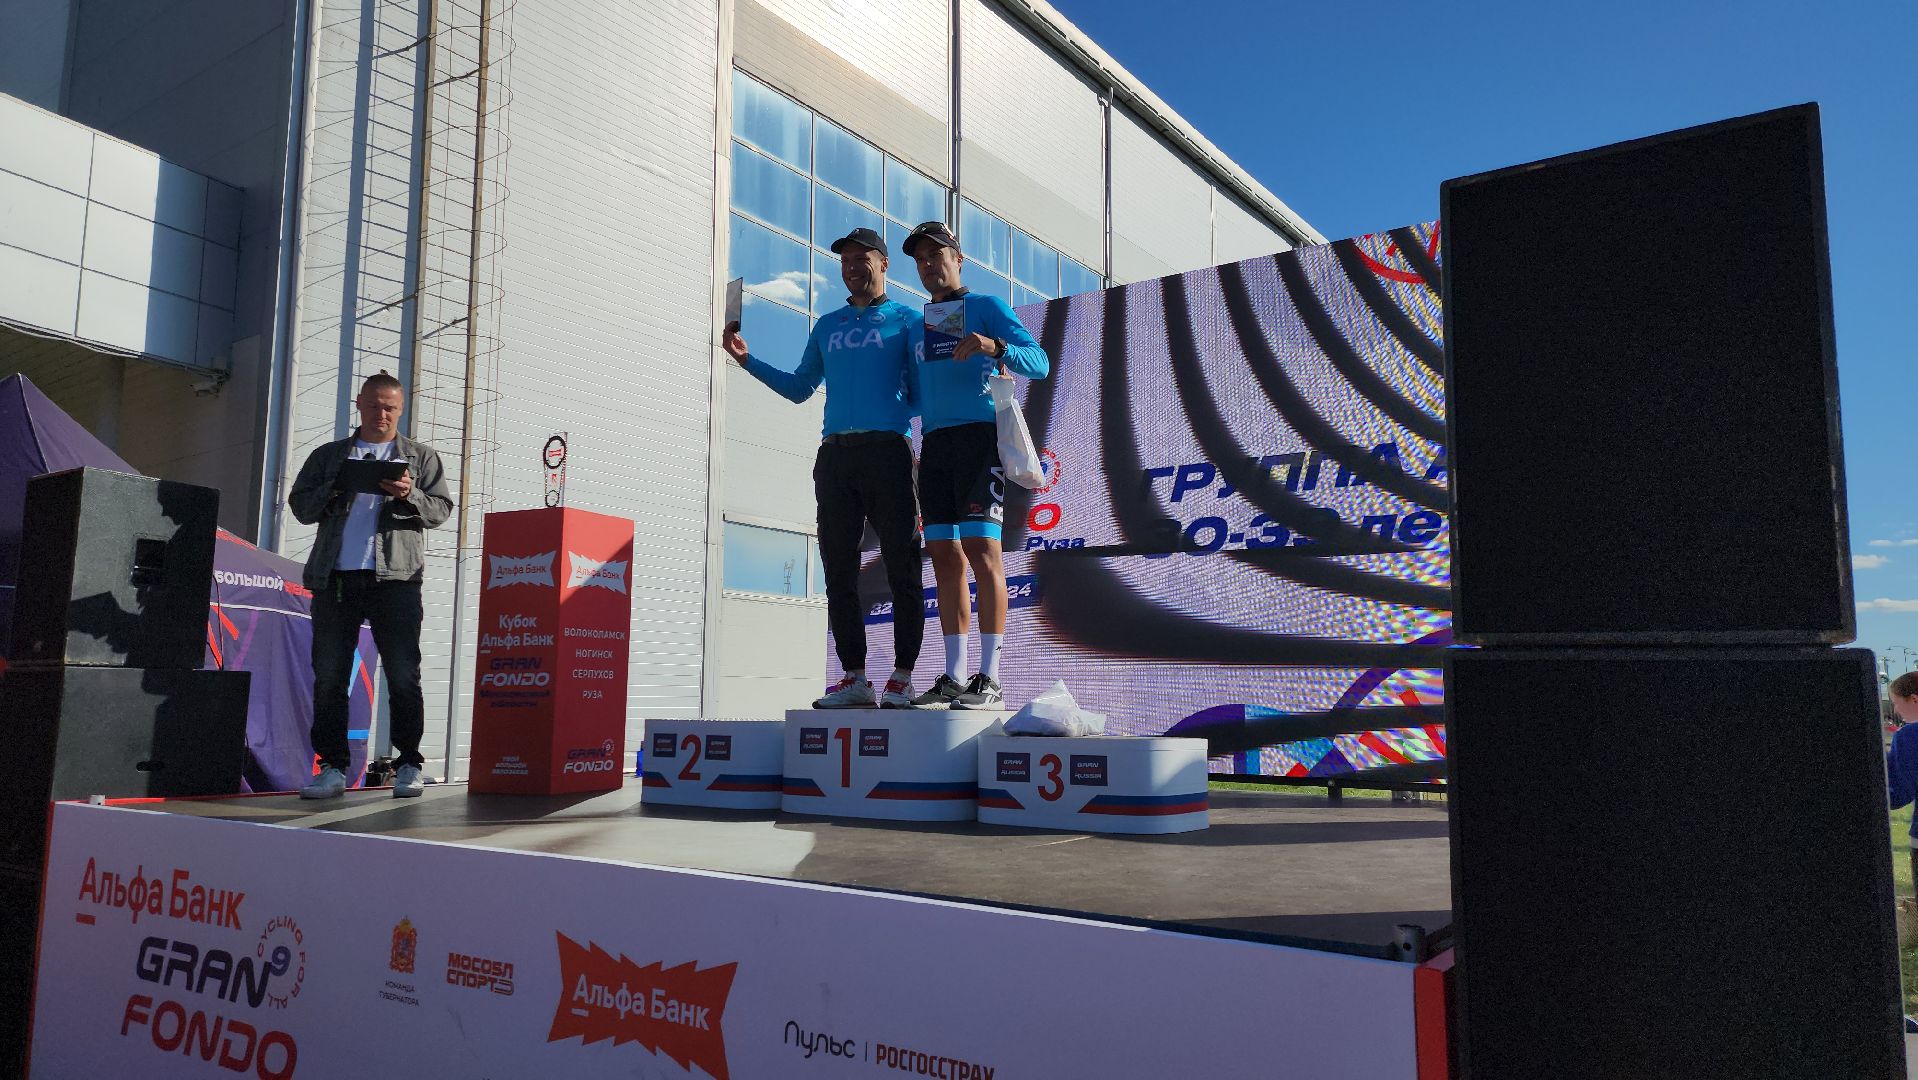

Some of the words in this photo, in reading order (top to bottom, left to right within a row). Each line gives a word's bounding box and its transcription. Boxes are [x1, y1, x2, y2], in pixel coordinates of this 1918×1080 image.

[828, 328, 884, 353] RCA
[1026, 537, 1086, 551] Руза
[214, 570, 283, 591] БОЛЬШОЙ
[496, 563, 524, 579] Альфа
[526, 563, 547, 574] Банк
[576, 565, 602, 580] Альфа
[603, 568, 620, 580] Банк
[499, 615, 537, 632] Кубок
[564, 628, 626, 641] ВОЛОКОЛАМСК
[481, 634, 520, 650] Альфа
[522, 633, 555, 646] Банк
[490, 658, 541, 669] GRAN
[575, 649, 612, 660] НОГИНСК
[480, 672, 550, 687] FONDO
[572, 669, 614, 681] СЕРПУХОВ
[582, 690, 602, 701] РУЗА
[563, 760, 614, 774] FONDO
[678, 733, 701, 780] 2
[833, 727, 851, 787] 1
[1037, 753, 1065, 802] 3
[78, 856, 163, 924] Альфа
[169, 868, 246, 930] Банк
[258, 916, 303, 957] CYCLING
[136, 936, 273, 1009] GRAN
[271, 946, 291, 977] 9
[291, 951, 306, 998] FOR
[448, 952, 514, 979] МОСОБЛ
[446, 969, 499, 993] СПОРТ
[268, 992, 289, 1010] ALL
[572, 974, 645, 1019] Альфа
[651, 987, 711, 1031] Банк
[120, 993, 298, 1080] FONDO
[784, 1019, 856, 1059] Пульс
[876, 1043, 996, 1080] РОСГОССТРАХ
